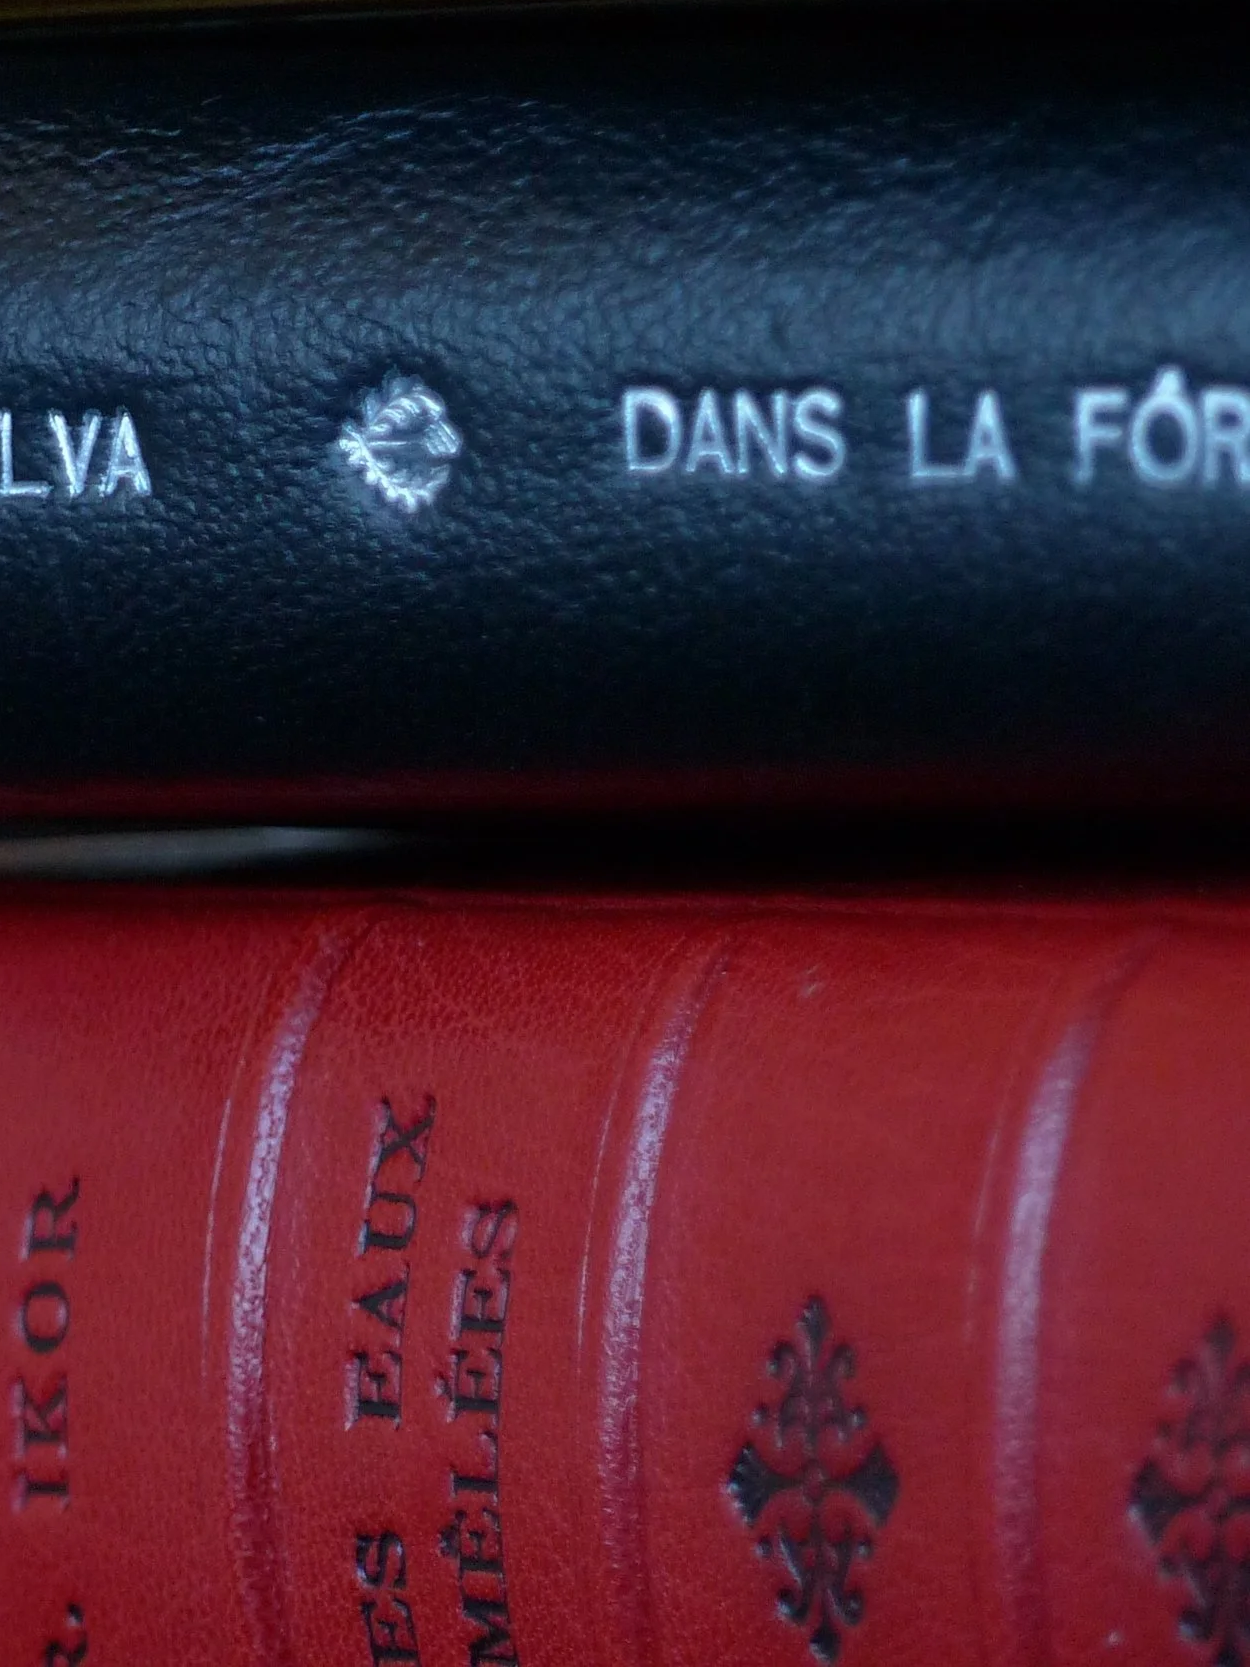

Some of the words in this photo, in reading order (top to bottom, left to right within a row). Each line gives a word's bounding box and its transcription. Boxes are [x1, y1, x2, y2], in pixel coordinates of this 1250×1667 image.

[621, 386, 847, 479] DANS
[905, 388, 1017, 482] LA
[12, 1177, 80, 1514] IKOR
[346, 1094, 437, 1430] EAUX
[434, 1200, 520, 1667] MÊLÉES
